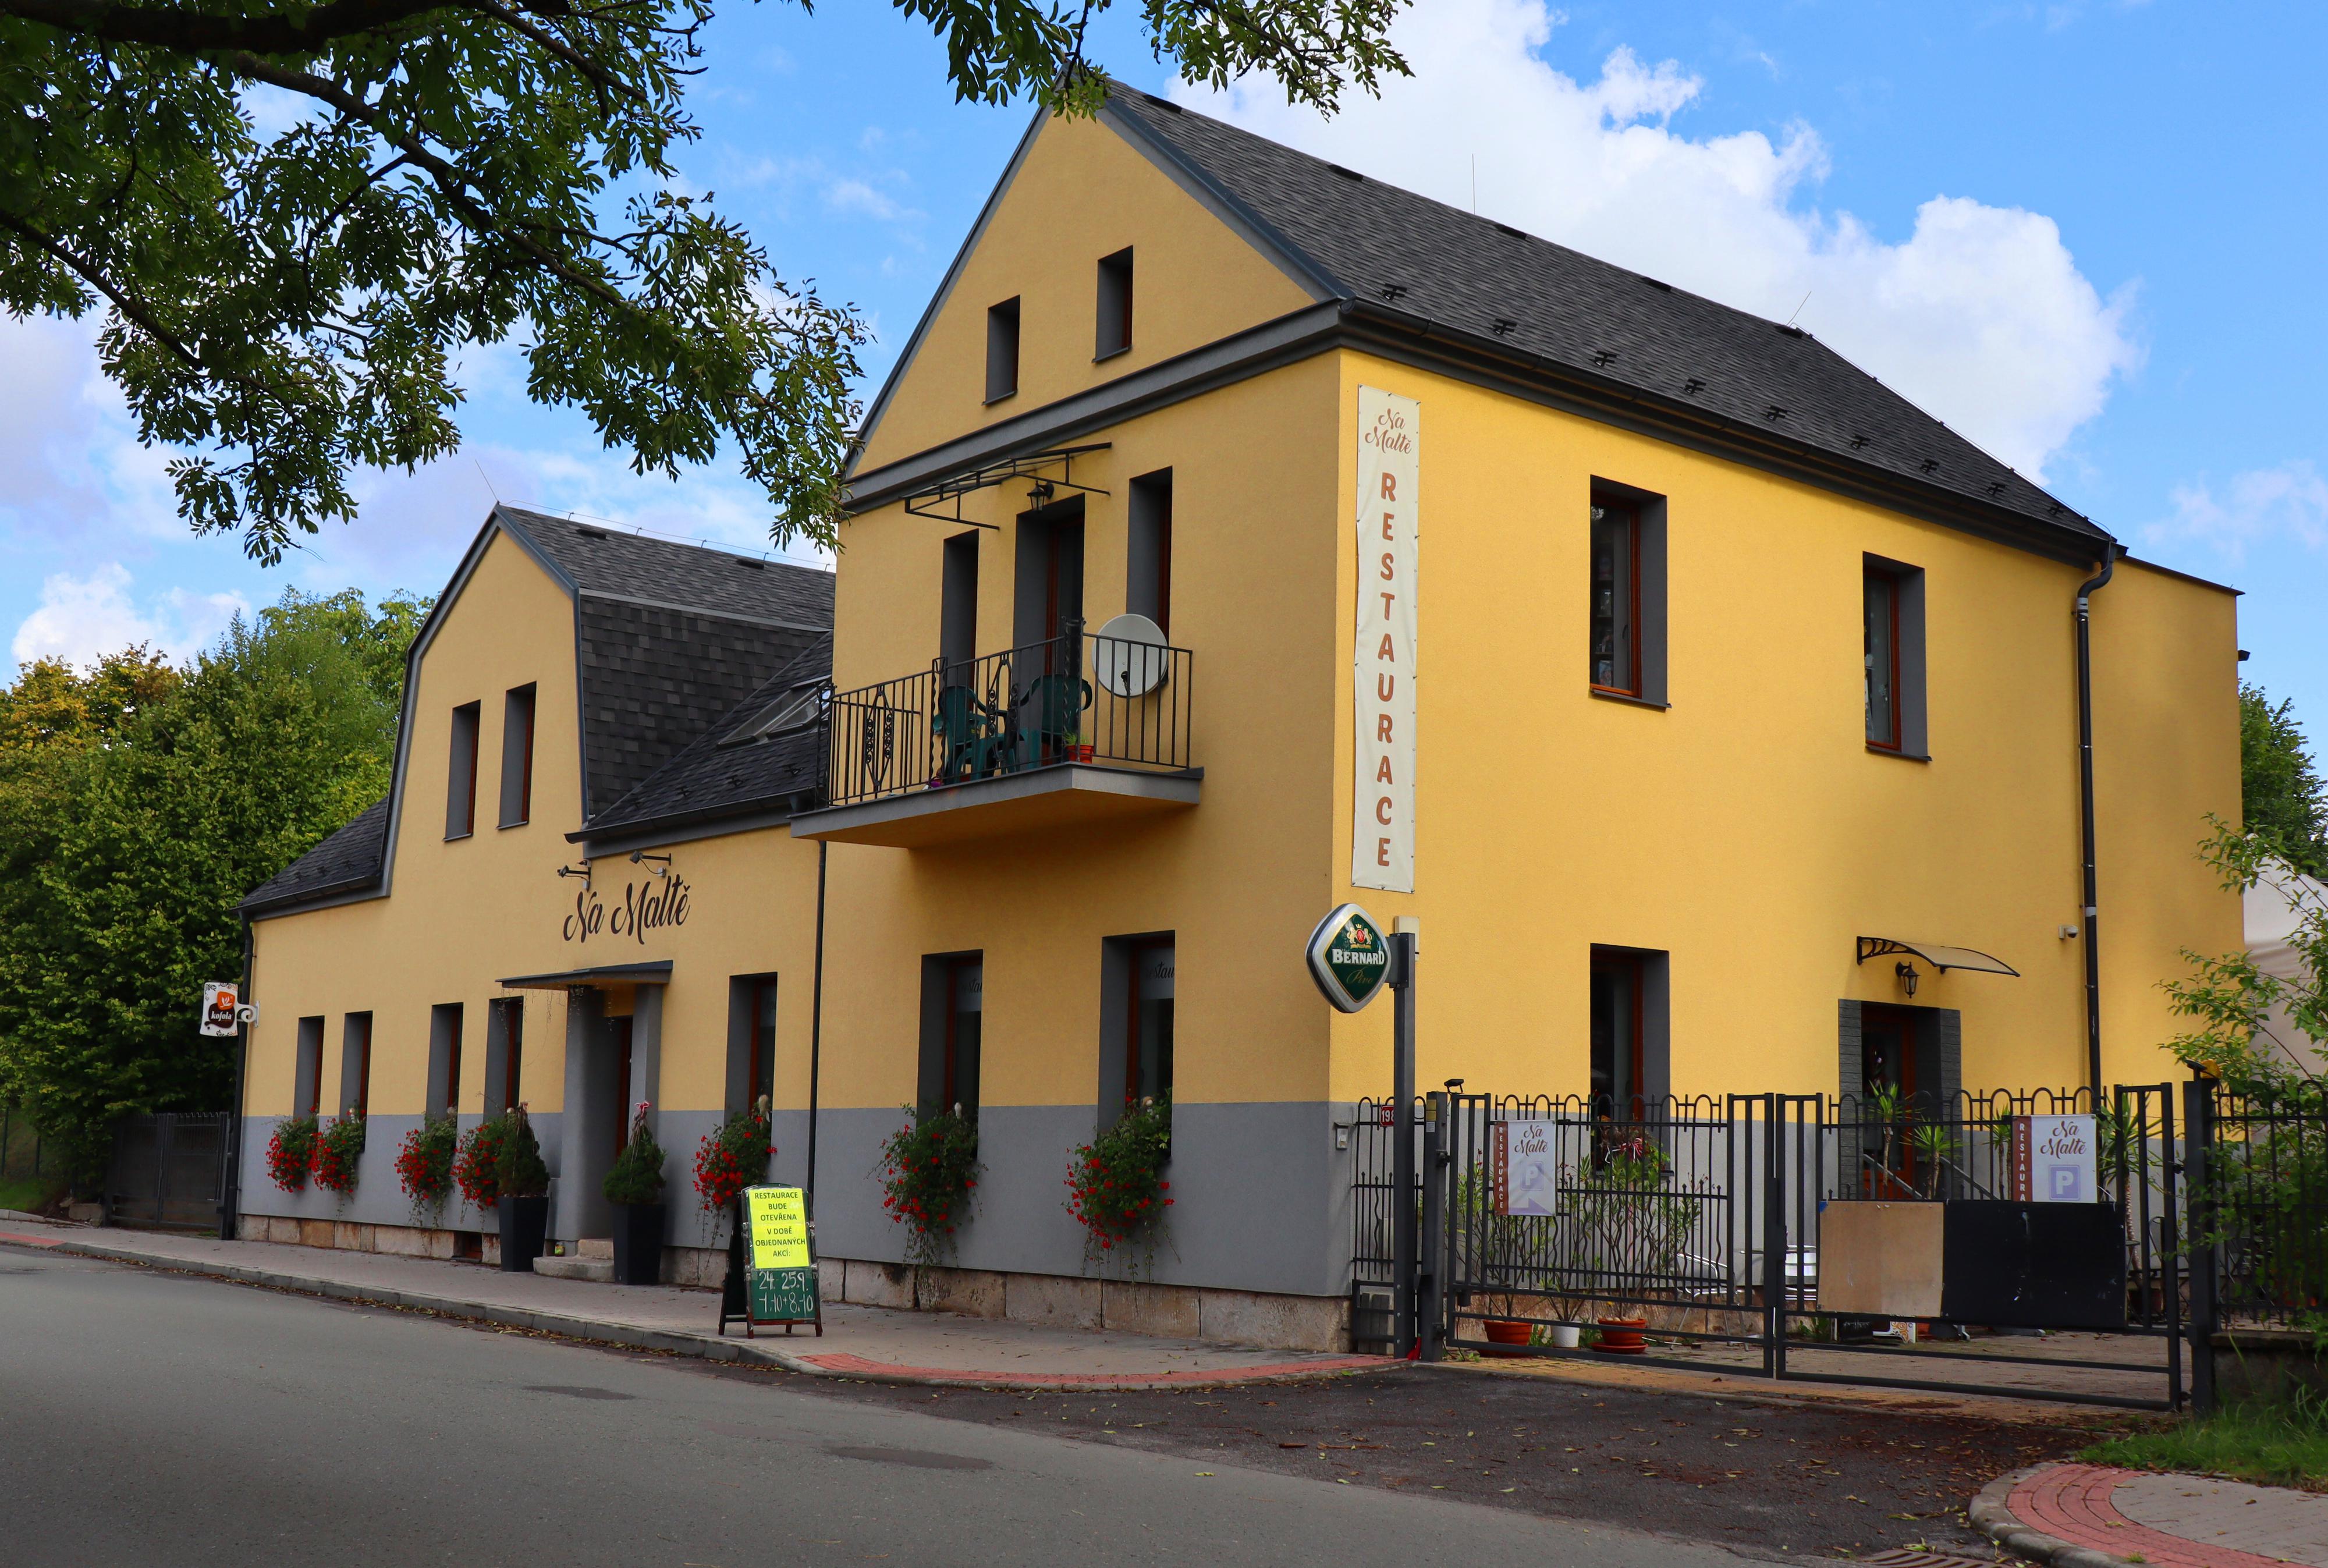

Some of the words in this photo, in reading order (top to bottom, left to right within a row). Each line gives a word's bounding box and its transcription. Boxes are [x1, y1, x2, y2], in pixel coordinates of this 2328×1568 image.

[1378, 408, 1406, 430] Na
[1364, 425, 1412, 454] Maltě
[1376, 472, 1396, 867] RESTAURACE
[563, 891, 605, 943] Na
[611, 874, 691, 945] Maltě
[1332, 949, 1385, 965] BERNARD
[211, 1010, 232, 1022] kofola
[1523, 1124, 1543, 1140] Na
[2052, 1120, 2079, 1138] Na
[1514, 1139, 1549, 1157] Maltě
[2039, 1138, 2087, 1159] Maltě
[1525, 1166, 1539, 1186] P
[2056, 1170, 2074, 1194] P
[760, 1212, 797, 1221] OTEVŘENA
[773, 1226, 792, 1234] DOBĚ
[755, 1237, 805, 1246] OBJEDNANÝCH
[773, 1248, 791, 1257] AKCÍ:
